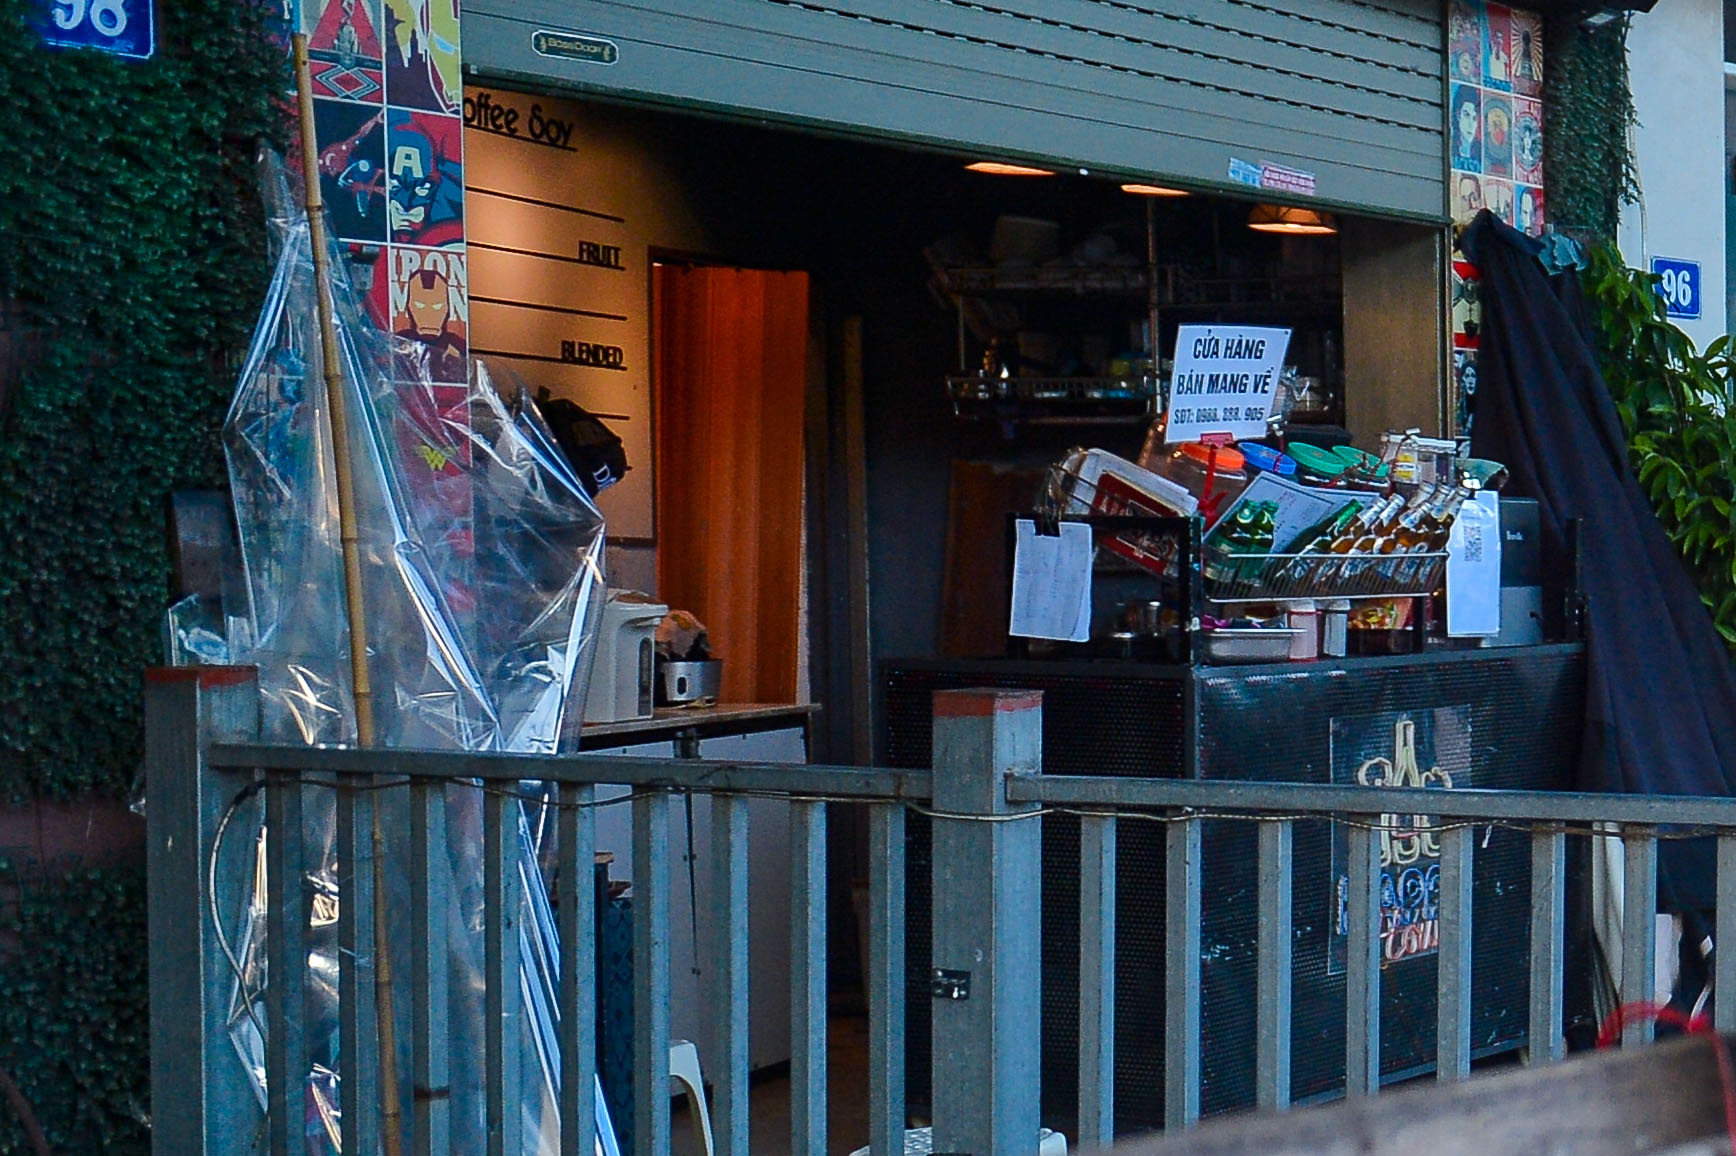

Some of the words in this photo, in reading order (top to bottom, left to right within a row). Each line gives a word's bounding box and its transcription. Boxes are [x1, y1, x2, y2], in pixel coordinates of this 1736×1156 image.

[464, 92, 519, 134] offee
[578, 240, 622, 267] FRUIT
[391, 281, 467, 322] MN
[1662, 268, 1692, 307] 96
[561, 340, 624, 365] BLENDED
[1192, 329, 1220, 359] CỬA
[1223, 334, 1266, 360] HÀNG
[1176, 368, 1205, 395] BÁN
[1206, 373, 1249, 394] MANG
[1252, 366, 1275, 395] VỀ
